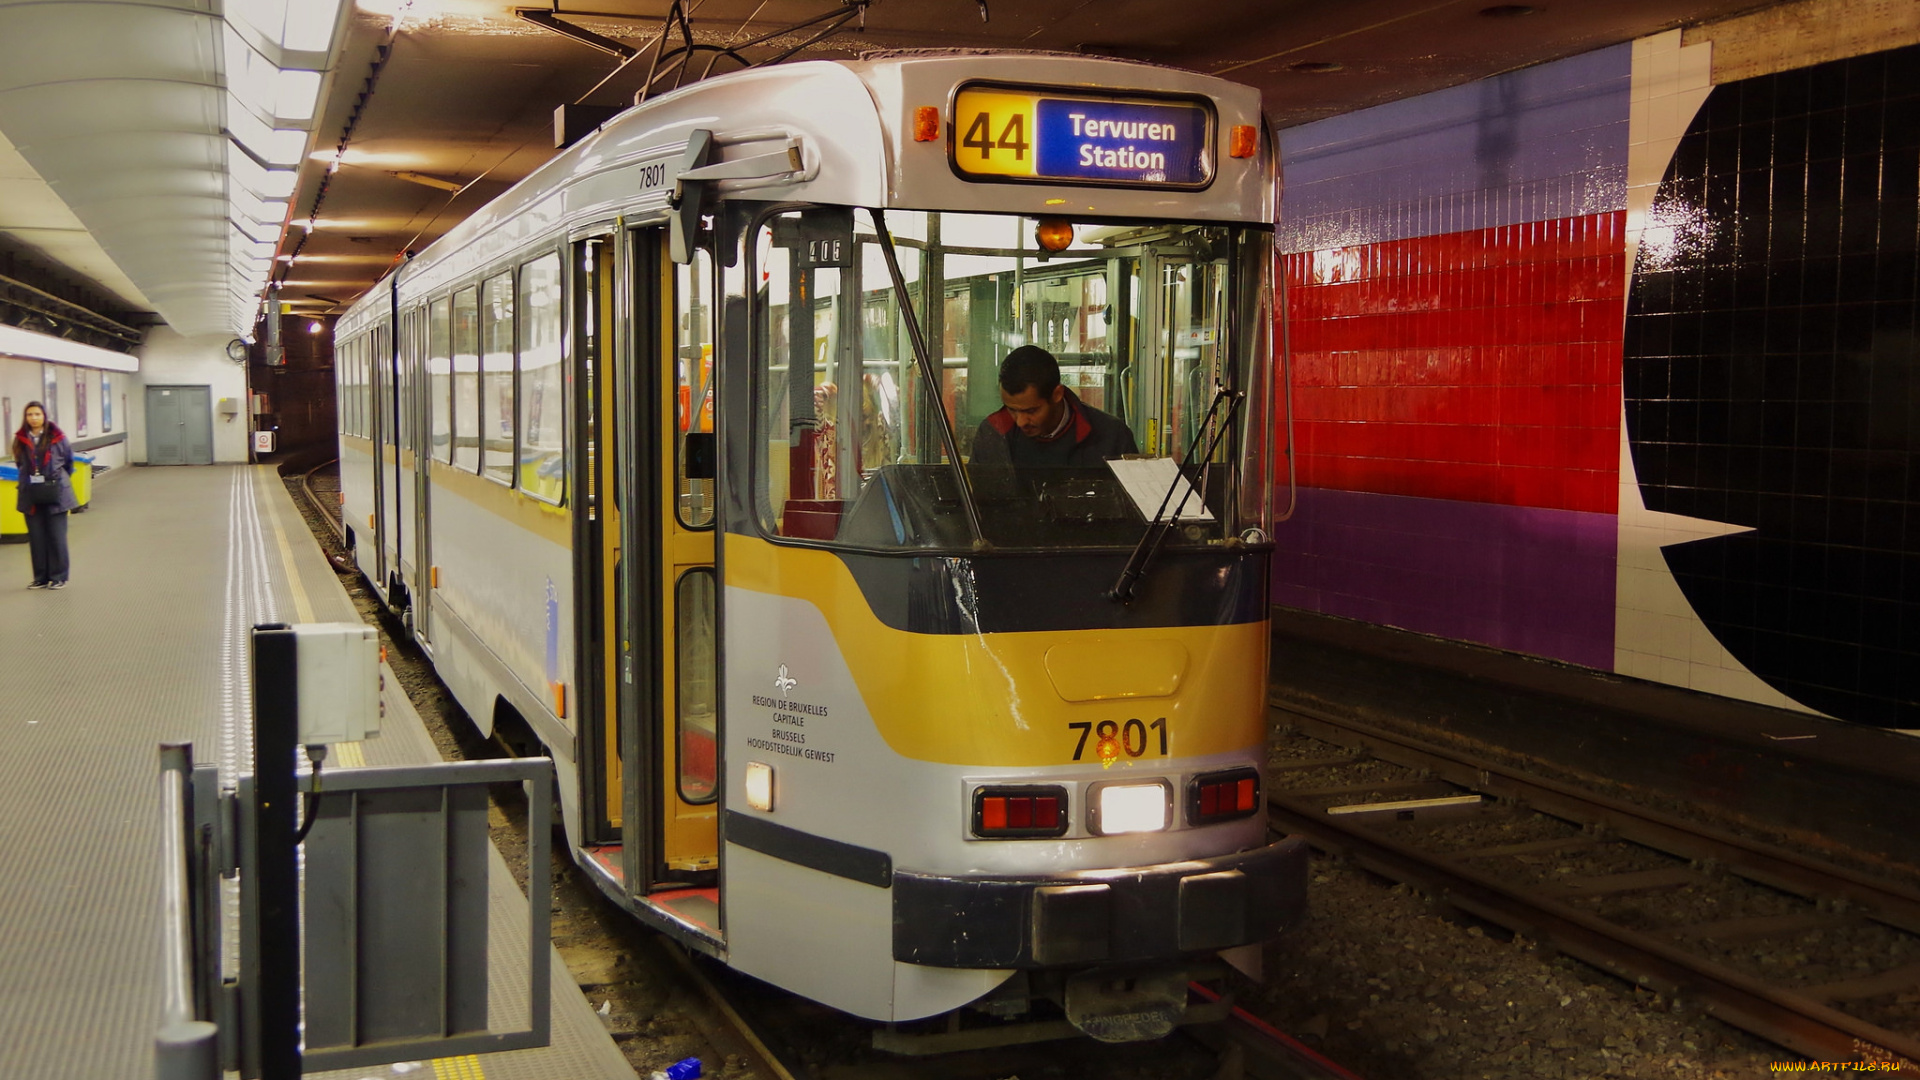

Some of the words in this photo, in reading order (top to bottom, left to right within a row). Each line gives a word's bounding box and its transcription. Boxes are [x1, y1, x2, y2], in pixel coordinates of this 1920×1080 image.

[963, 112, 1029, 160] 44
[1068, 113, 1176, 141] Tervuren
[1079, 144, 1165, 169] Station
[639, 163, 666, 190] 7801
[752, 695, 777, 709] REGION
[778, 699, 788, 711] DE
[788, 701, 828, 717] BRUXELLES
[773, 712, 805, 727] CAPITALE
[772, 729, 806, 744] BRUSSELS
[1068, 717, 1168, 761] 7801
[747, 737, 803, 758] HOOFDSTEDELIJK
[804, 748, 835, 763] GEWEST
